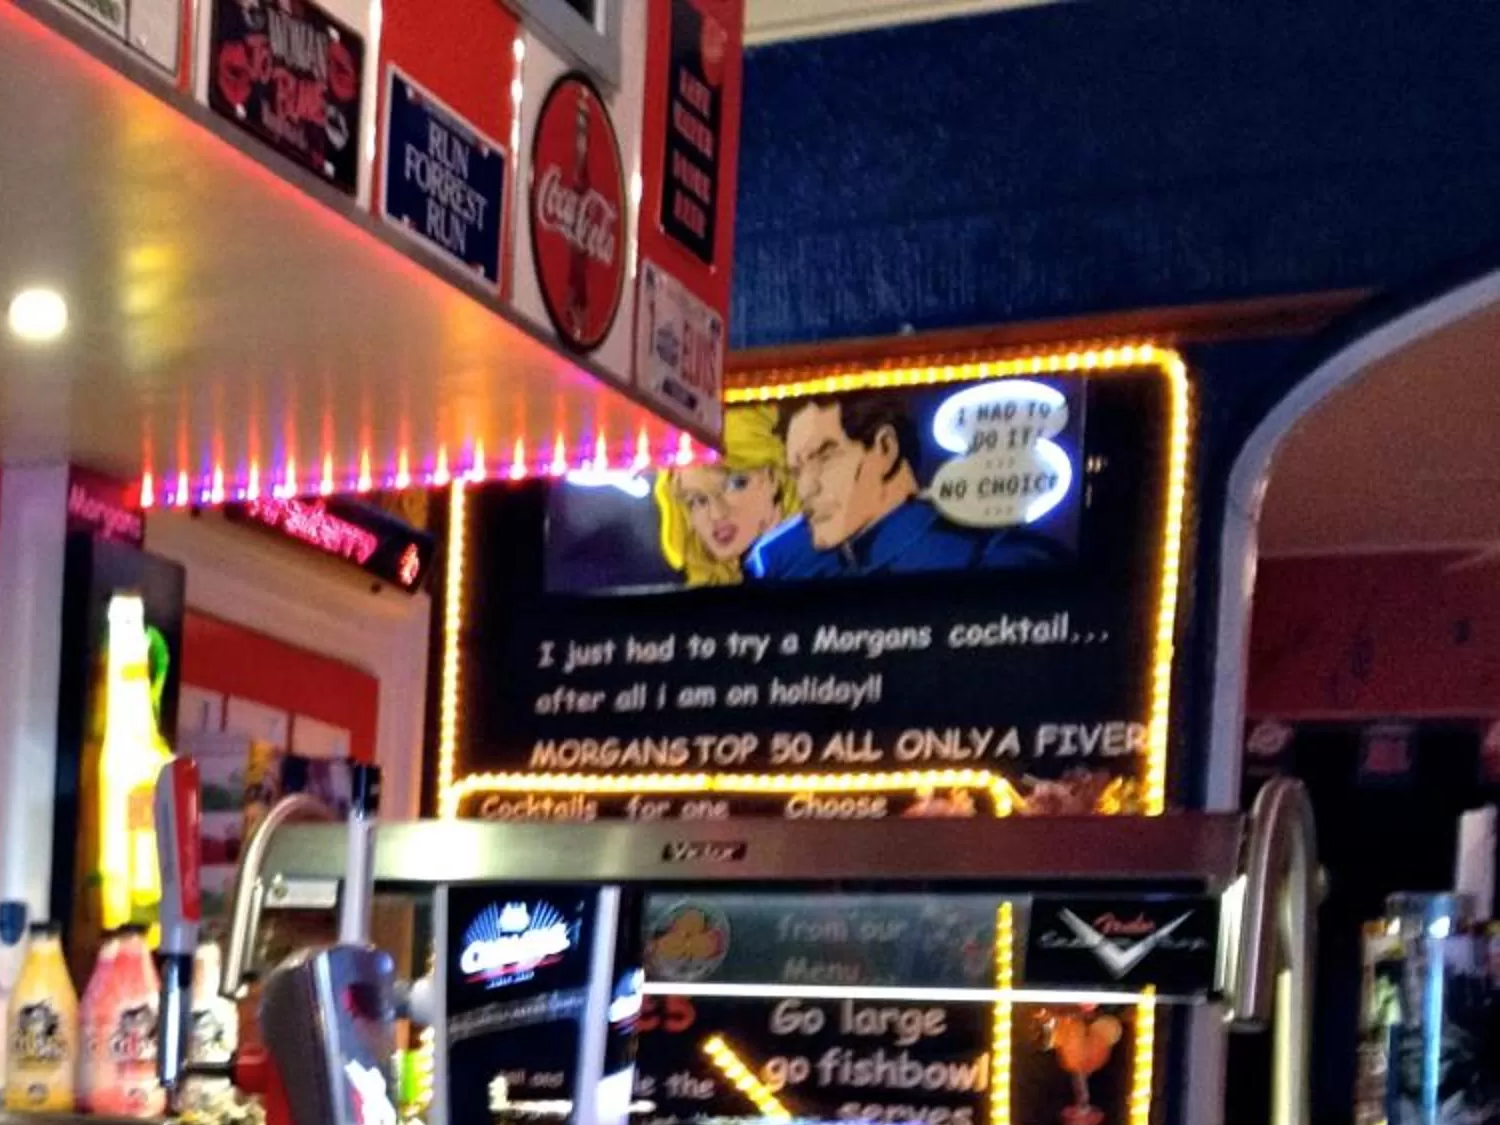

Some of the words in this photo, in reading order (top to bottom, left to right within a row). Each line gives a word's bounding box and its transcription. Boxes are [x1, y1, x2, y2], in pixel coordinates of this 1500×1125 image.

[428, 118, 470, 180] RUN
[426, 198, 467, 256] RUN
[939, 479, 968, 499] NO
[537, 640, 556, 669] I
[563, 638, 616, 674] just
[626, 634, 675, 665] had
[687, 632, 716, 659] to
[726, 631, 770, 663] try
[781, 633, 799, 655] a
[812, 624, 932, 658] Morgans
[534, 682, 605, 715] after
[613, 682, 647, 711] all
[676, 685, 717, 709] am
[725, 683, 759, 708] on
[529, 734, 691, 770] MORGANS
[691, 733, 759, 765] TOP
[770, 731, 813, 765] 50
[820, 728, 884, 763] ALL
[895, 726, 995, 761] ONLY
[995, 726, 1021, 757] A
[1033, 721, 1150, 758] FIVER
[680, 799, 730, 821] one
[784, 793, 889, 821] Choose
[768, 997, 825, 1037] Go
[839, 1000, 949, 1044] large
[763, 1055, 811, 1092] go
[817, 1047, 991, 1093] fishbowl
